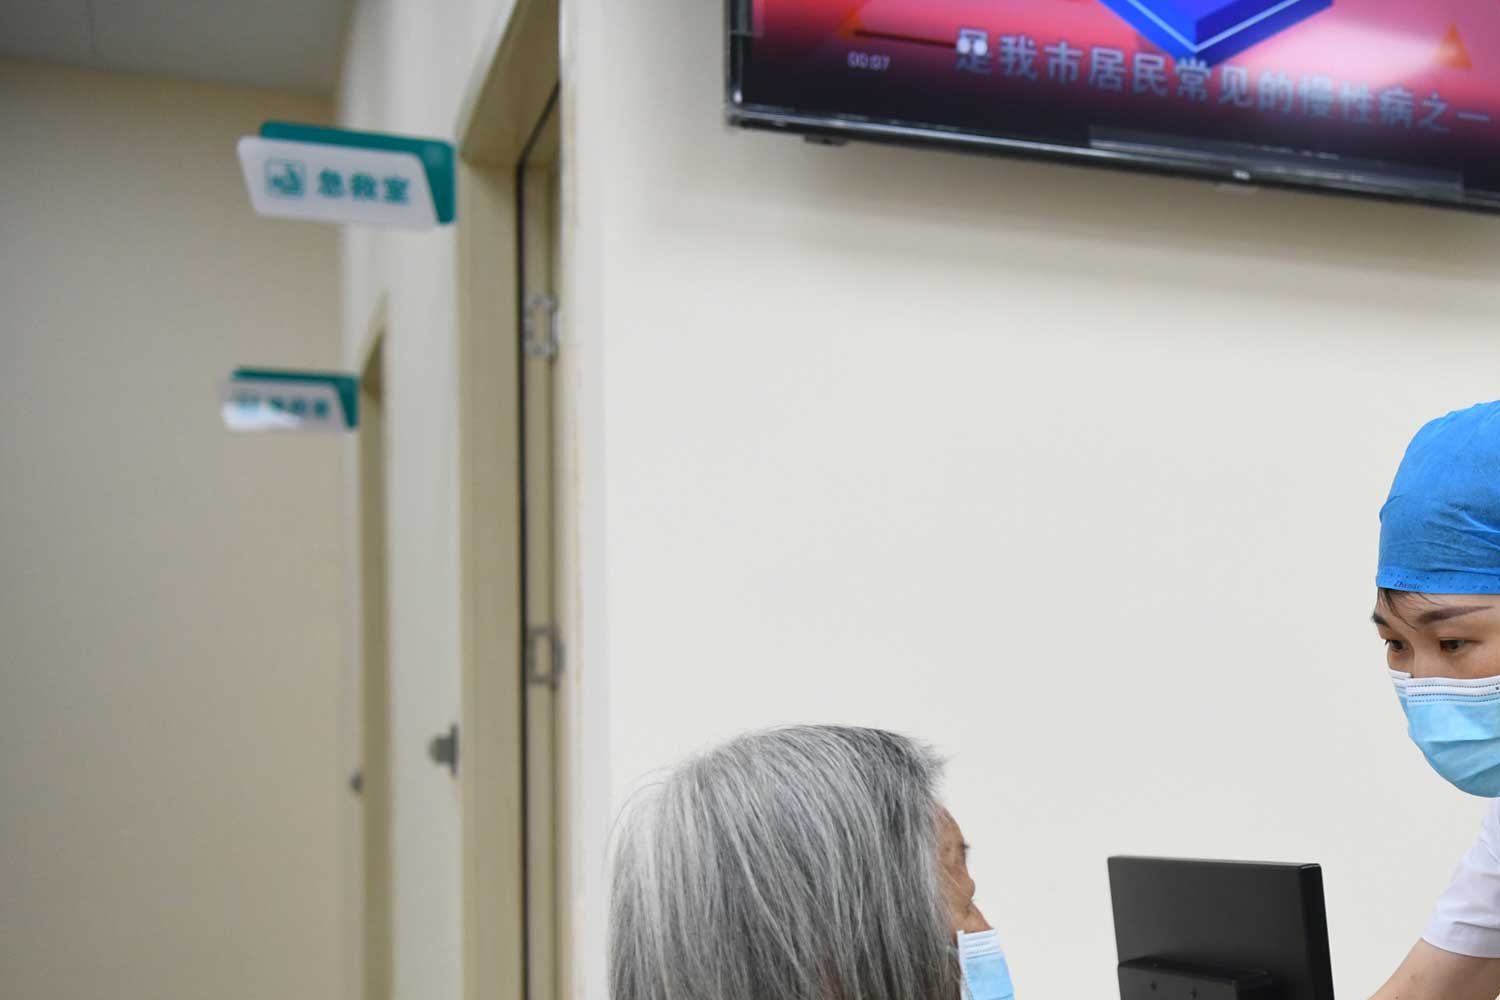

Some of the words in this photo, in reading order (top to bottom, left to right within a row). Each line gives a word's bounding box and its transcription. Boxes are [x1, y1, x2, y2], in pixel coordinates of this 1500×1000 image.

[956, 27, 1491, 132] 是我市居民常见的慢性病之一
